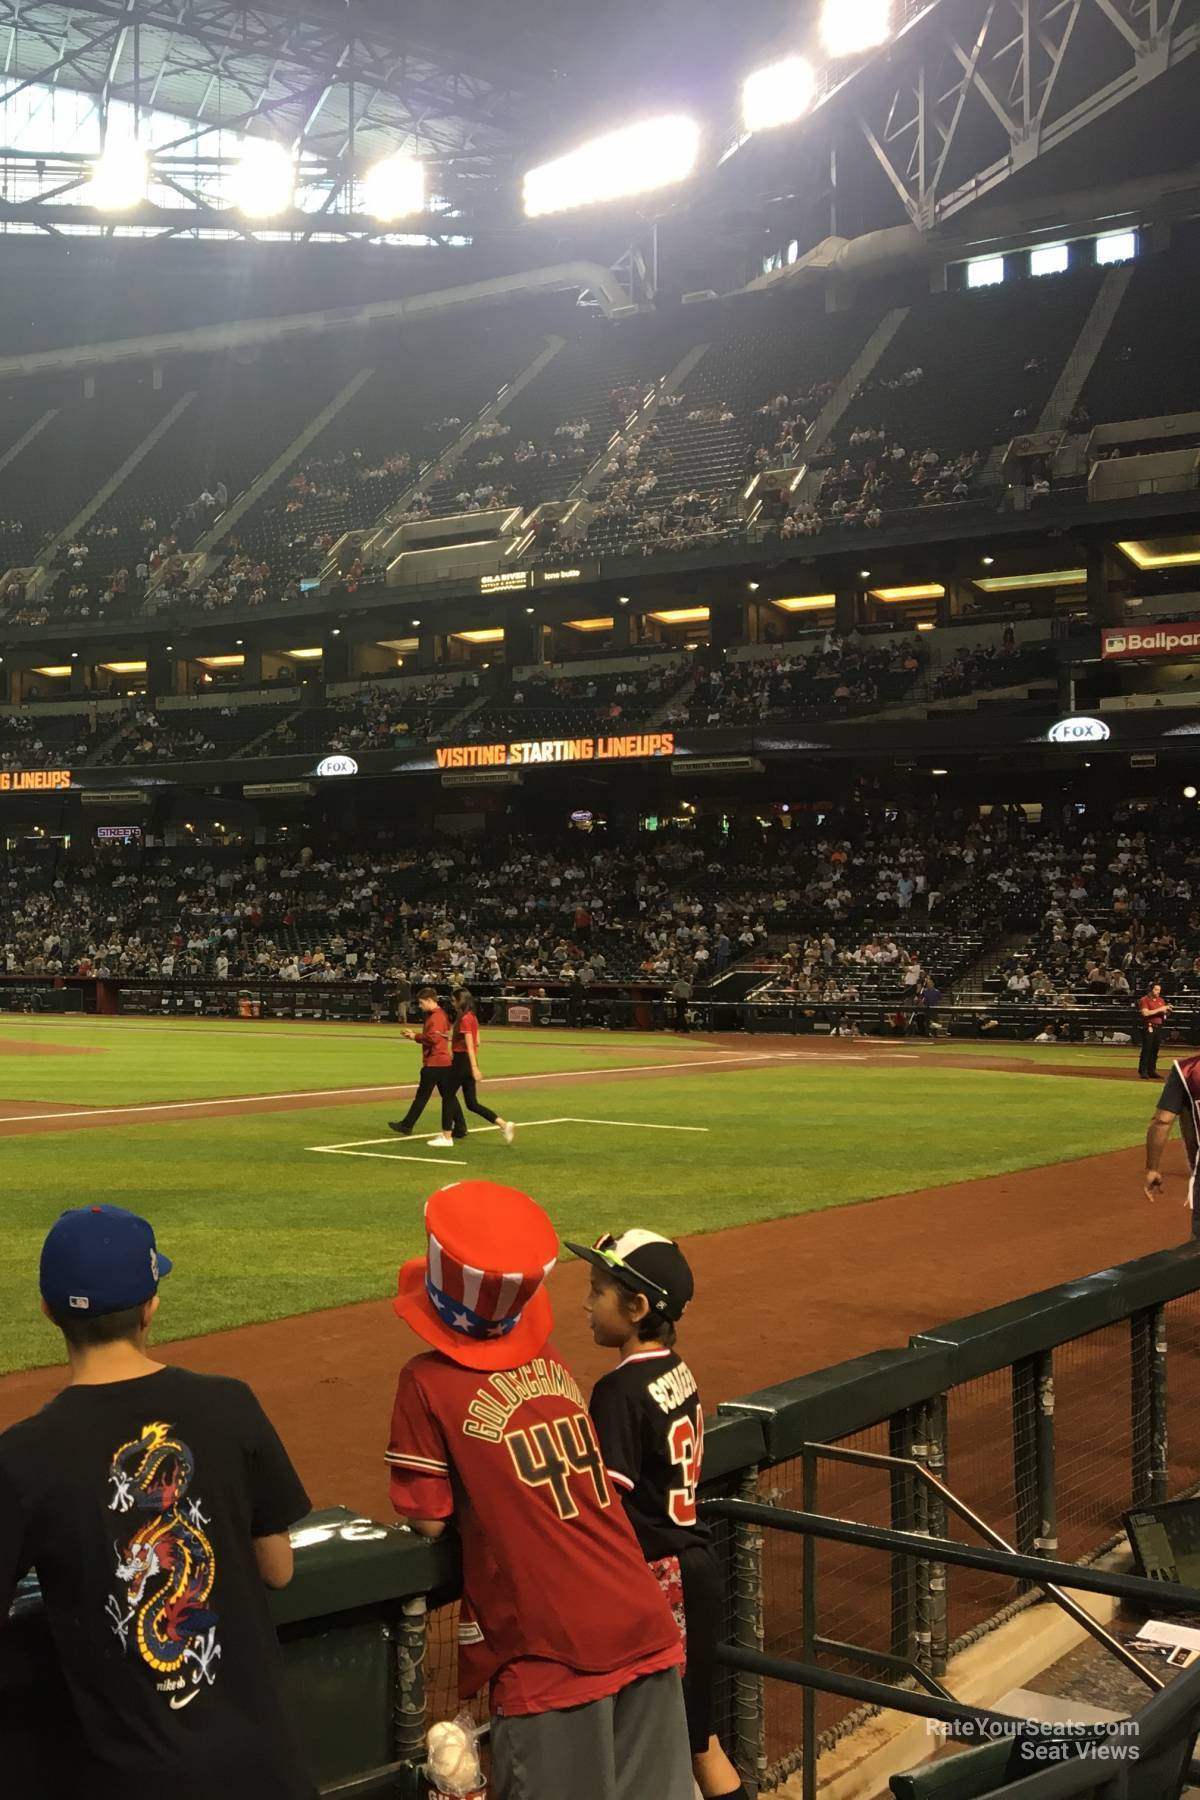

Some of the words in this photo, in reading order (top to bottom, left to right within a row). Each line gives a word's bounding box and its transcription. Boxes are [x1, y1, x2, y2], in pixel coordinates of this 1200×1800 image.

[1063, 724, 1094, 737] FOX
[436, 744, 506, 769] VISITING
[509, 738, 594, 765] STARTING
[597, 733, 674, 759] LINEUPS
[326, 761, 348, 772] FOX
[13, 770, 71, 790] LINEUPS
[503, 1413, 611, 1520] 44
